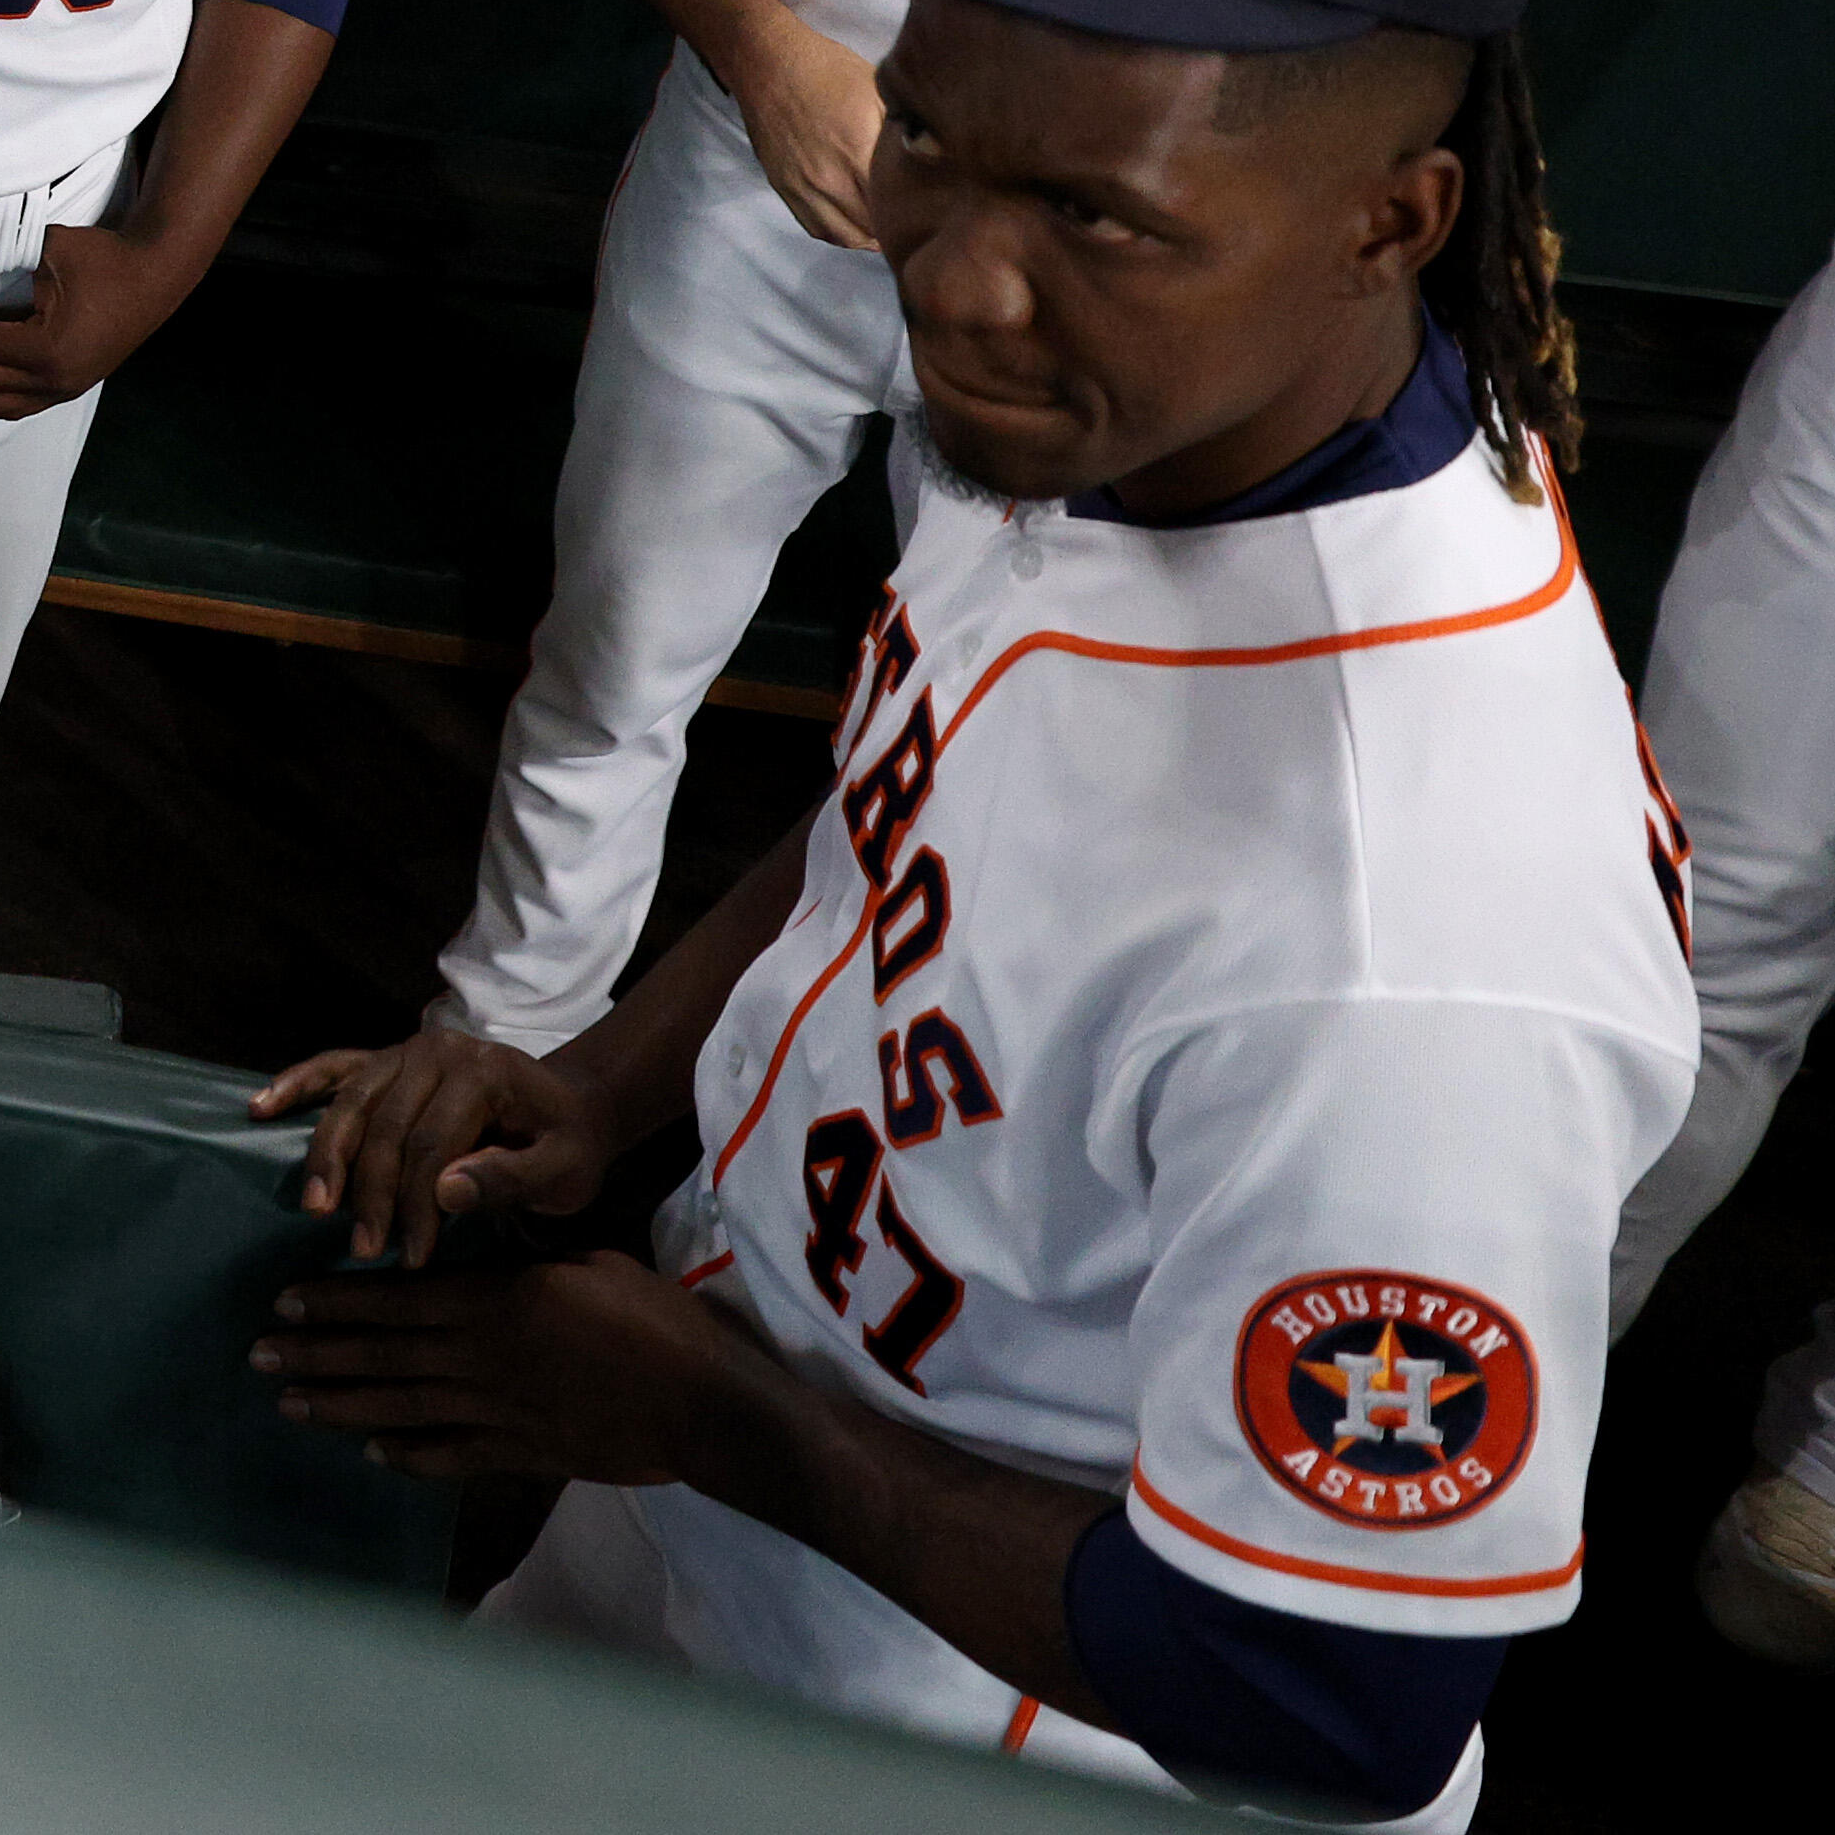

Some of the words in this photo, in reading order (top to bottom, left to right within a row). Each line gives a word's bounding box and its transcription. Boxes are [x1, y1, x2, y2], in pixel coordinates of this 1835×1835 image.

[803, 1107, 966, 1400] 47
[1270, 1284, 1510, 1360] HOUSTON
[1333, 1352, 1446, 1445] H
[1282, 1448, 1493, 1516] ASTROS
